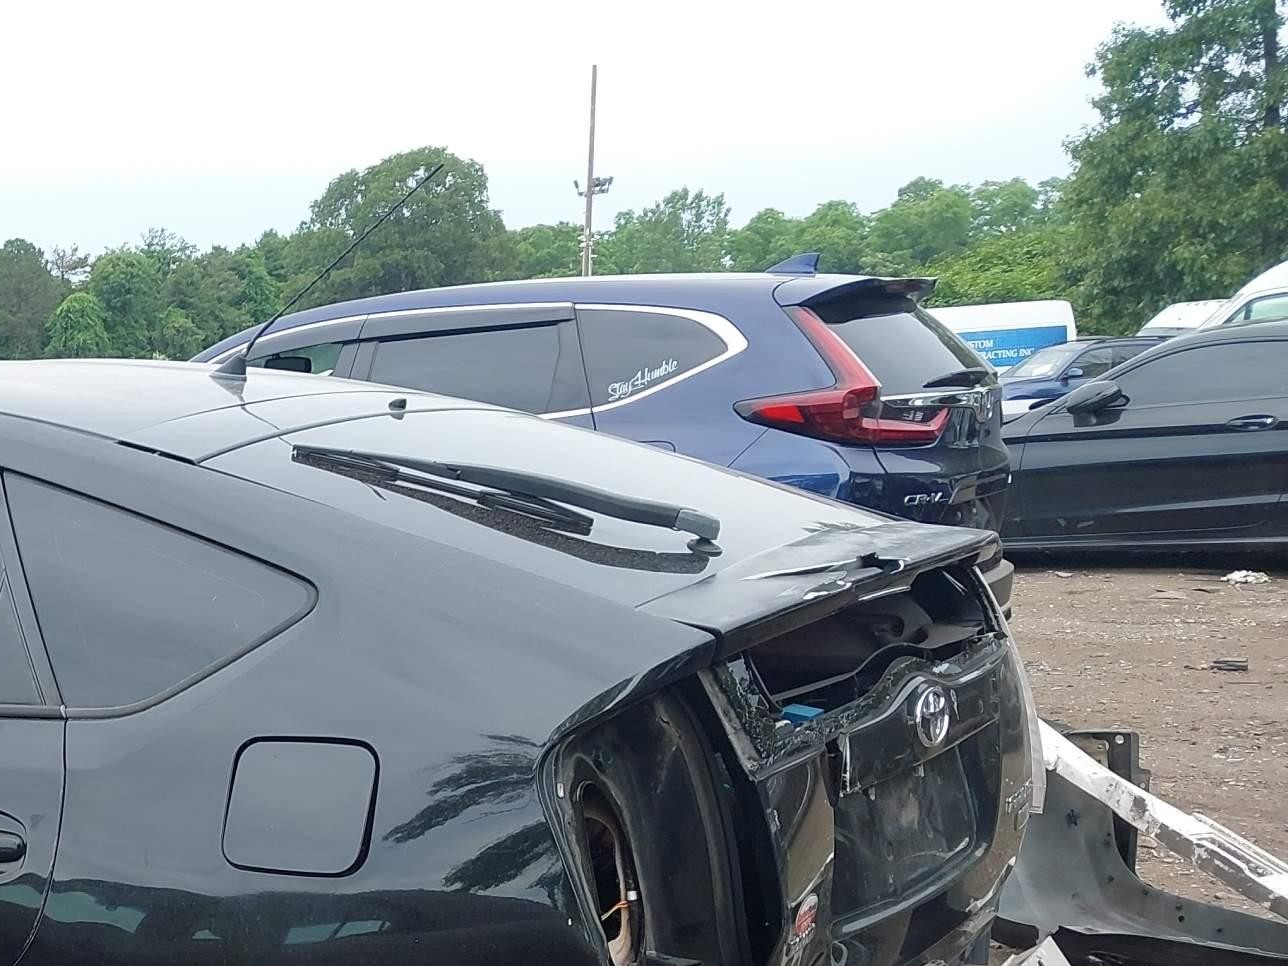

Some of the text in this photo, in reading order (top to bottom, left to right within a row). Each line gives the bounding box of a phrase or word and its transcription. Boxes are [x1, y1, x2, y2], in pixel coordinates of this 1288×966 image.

[968, 340, 993, 349] STOM
[979, 350, 1017, 360] RACTING
[608, 358, 678, 402] Stay Humble
